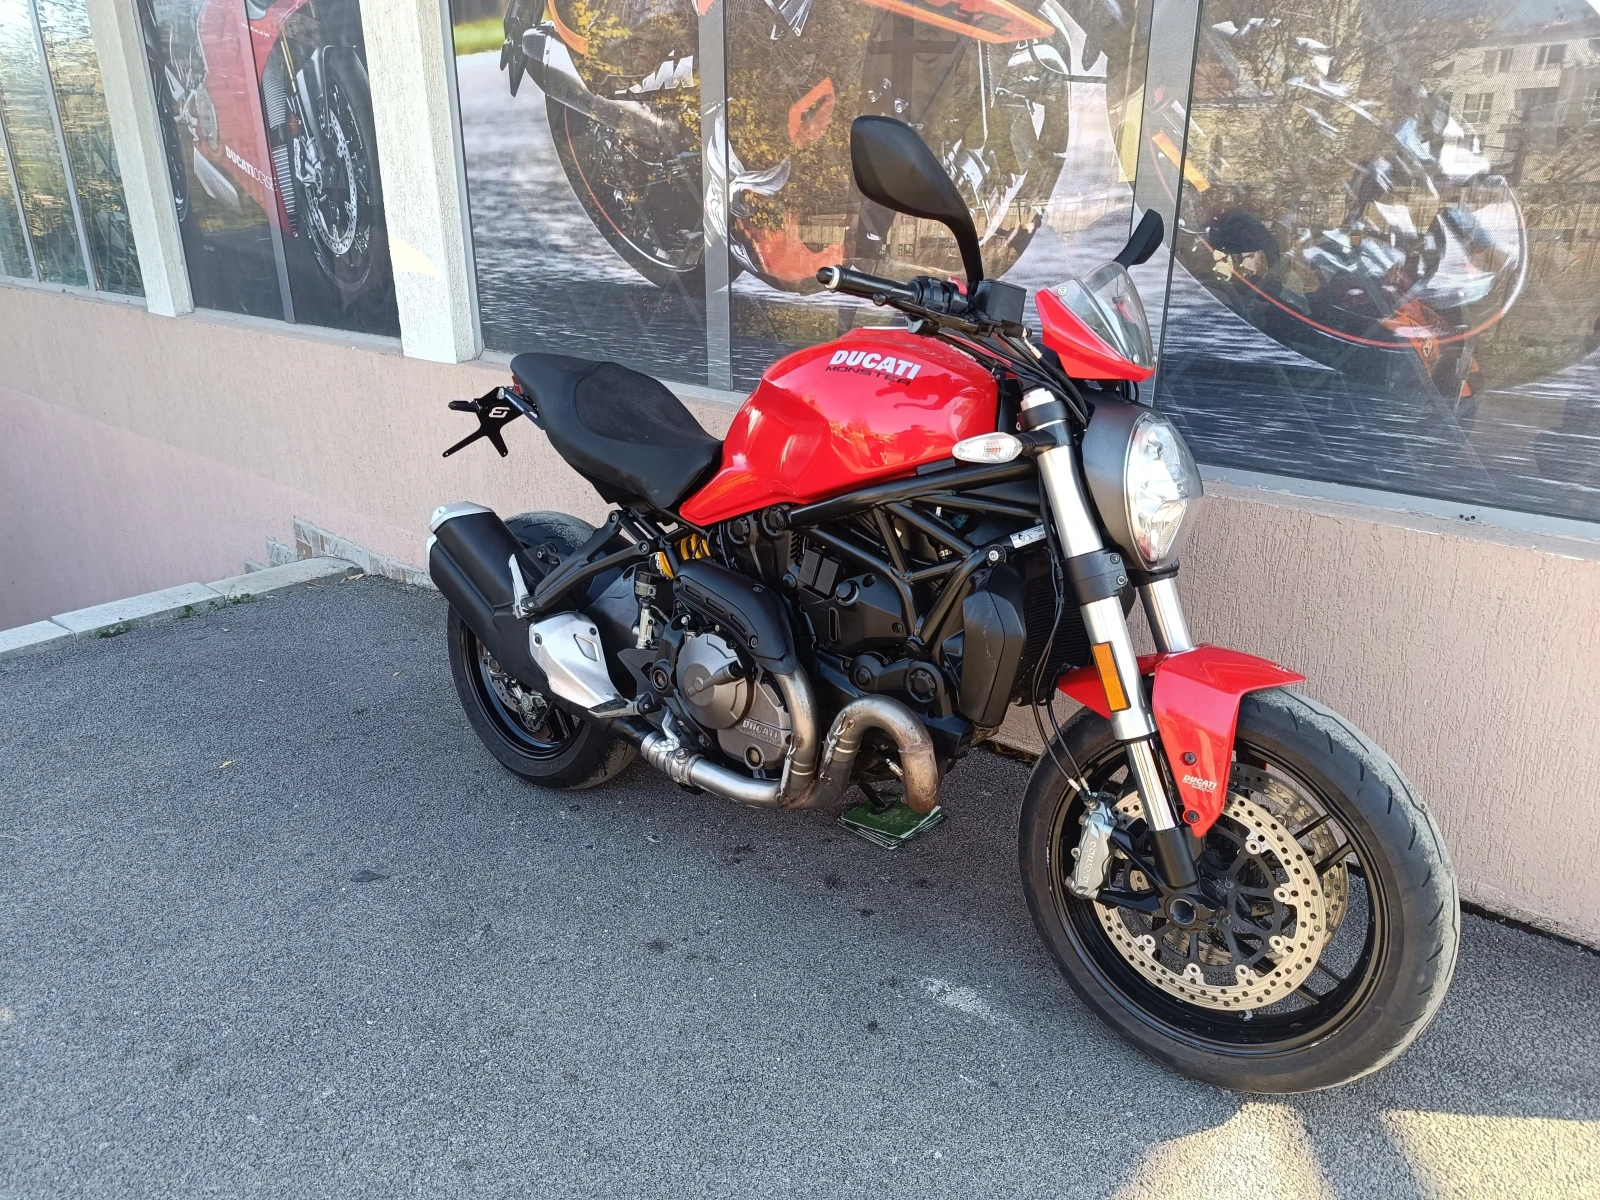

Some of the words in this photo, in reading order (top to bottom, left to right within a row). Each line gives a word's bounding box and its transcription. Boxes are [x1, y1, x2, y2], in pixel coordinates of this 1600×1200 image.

[225, 145, 254, 178] DUCATI
[825, 366, 911, 386] MONSTER
[829, 350, 921, 380] DUCATI
[742, 720, 778, 739] DUCATI
[1183, 774, 1217, 789] DUCATI
[1080, 841, 1097, 883] brembo
